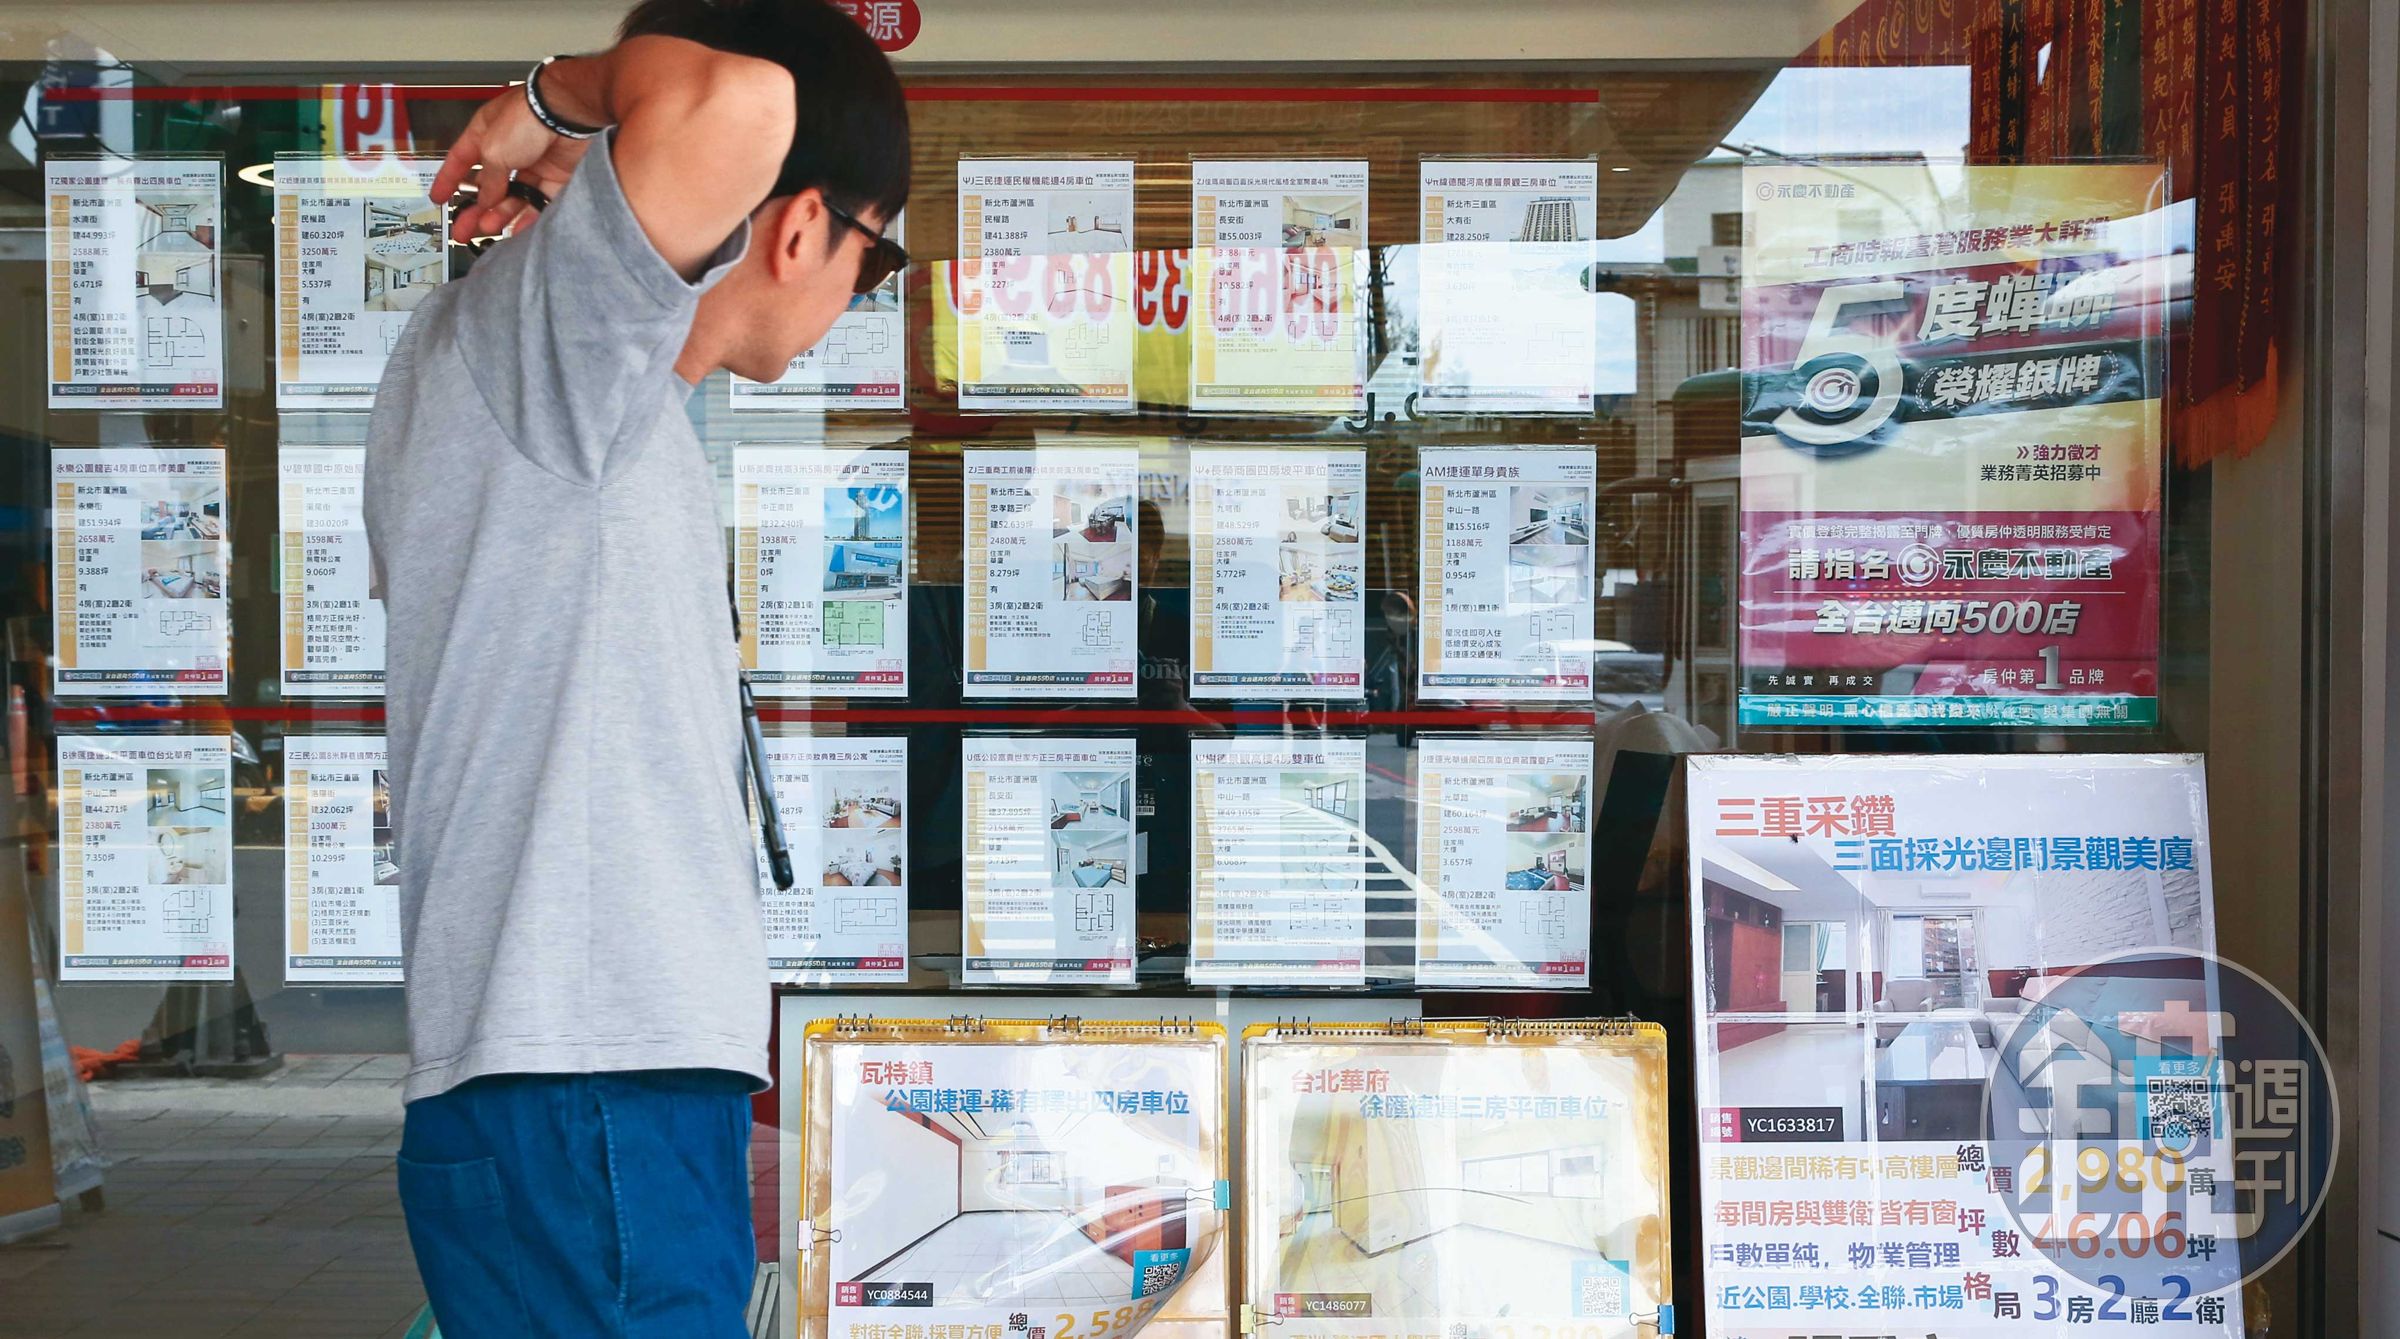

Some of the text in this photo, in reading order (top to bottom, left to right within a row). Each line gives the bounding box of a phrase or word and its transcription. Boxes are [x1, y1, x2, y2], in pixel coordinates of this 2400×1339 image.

[1777, 183, 1856, 199] 永慶不動產
[1447, 200, 1496, 208] 新北市三重區
[302, 231, 344, 239] 建60.320坪
[985, 231, 1028, 239] 建41.388坪
[1219, 232, 1262, 240] 建55.003坪
[1447, 233, 1490, 241] 建28.250坪
[302, 280, 331, 288] 5.537坪
[1773, 281, 1904, 445] 5
[1931, 356, 2101, 408] 榮耀銀牌
[2033, 445, 2101, 461] 強力徵才
[1425, 466, 1520, 478] AM捷運單身貴族
[1981, 464, 2101, 481] 業務菁英招募中
[1447, 522, 1489, 531] 建15.516坪
[1957, 525, 2111, 539] 優質房仲透明服務受肯定
[79, 535, 114, 543] 2658萬元
[761, 536, 796, 544] 1938萬元
[1217, 537, 1253, 545] 2580萬元
[1447, 539, 1483, 547] 1188萬元
[1788, 548, 2113, 581] 請指名 永慶不動產
[990, 569, 1019, 577] 8.279坪
[1217, 570, 1246, 578] 5.772坪
[990, 602, 1043, 610] 3房(室)2廳2衛
[1216, 602, 1270, 611] 4房(室)2廳2衛
[1813, 600, 2081, 635] 全台邁向500店
[1768, 675, 1873, 686] 先誠實 再成交
[86, 805, 127, 813] 建44.271坪
[1715, 796, 1896, 838] 三重采鑽
[312, 822, 346, 830] 1300萬元
[1444, 826, 1480, 834] 2598萬元
[1833, 836, 2193, 872] 三面採光邊間景觀美廈
[860, 1061, 934, 1085] 瓦特鎮
[2158, 1061, 2200, 1074] 看更多
[1291, 1070, 1390, 1093] 台北華府
[1747, 1118, 1835, 1132] YC1633817
[1709, 1156, 1959, 1181] 景觀邊間稀有中高樓層
[1714, 1200, 1957, 1226] 每間房與雙衛皆有窗
[867, 1289, 928, 1301] YC0884544
[1305, 1300, 1366, 1312] YC1486077
